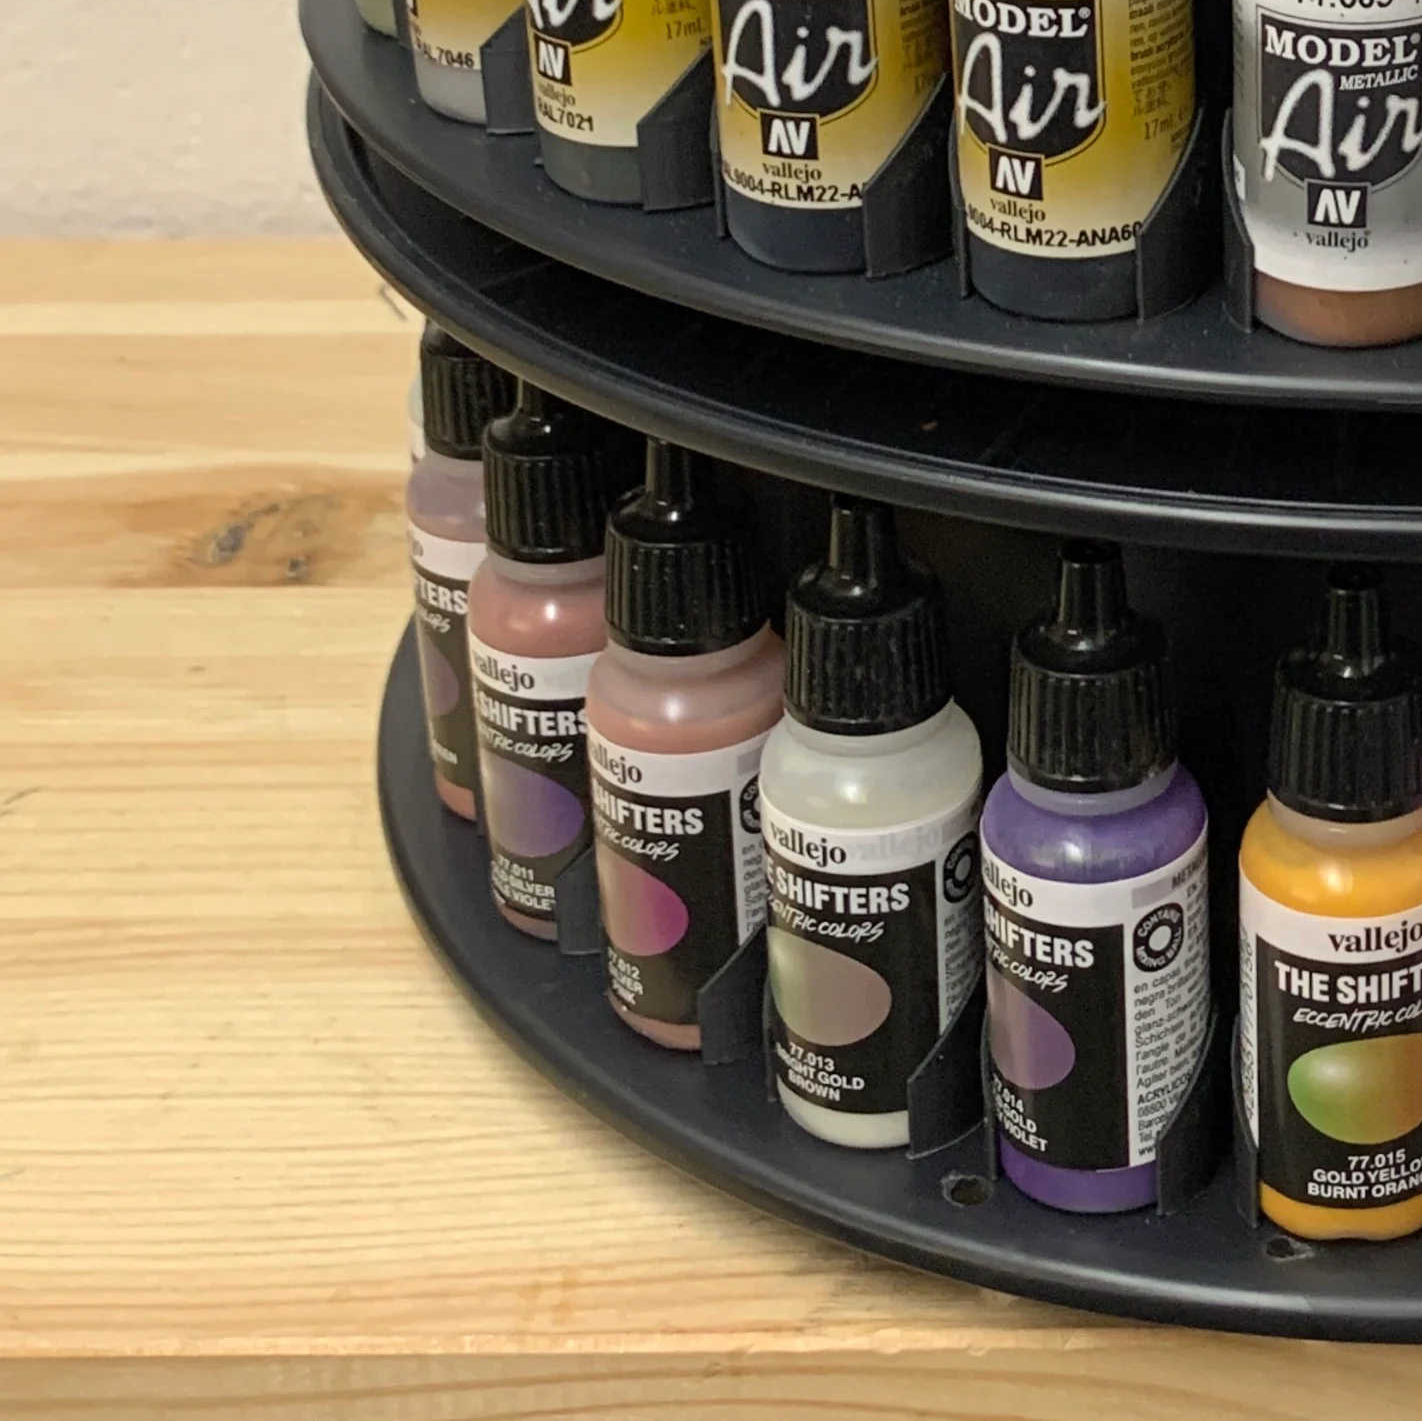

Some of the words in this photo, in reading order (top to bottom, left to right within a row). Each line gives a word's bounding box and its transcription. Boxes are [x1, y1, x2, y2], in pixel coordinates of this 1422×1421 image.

[1263, 25, 1419, 68] MODEL
[957, 31, 1107, 144] Air
[1339, 64, 1420, 92] METALLIC
[762, 160, 823, 183] vallejo
[990, 197, 1047, 223] vallejo
[1304, 229, 1371, 253] vallejo
[514, 742, 574, 763] COLORS
[621, 835, 680, 862] COLORS
[769, 822, 848, 868] vallejo
[510, 891, 556, 912] VIOLE
[777, 869, 911, 915] SHIFTERS
[818, 919, 885, 943] COLORS
[1010, 961, 1069, 993] COLORS
[1273, 959, 1331, 1002] THE
[1292, 1006, 1393, 1034] ECCENTRIC
[788, 1040, 836, 1072] 77.013
[787, 1068, 842, 1103] BROWN
[816, 1068, 866, 1091] GOLD
[1347, 1148, 1406, 1171] 77.015
[1306, 1181, 1370, 1200] BURNT
[1312, 1168, 1364, 1186] GOLD
